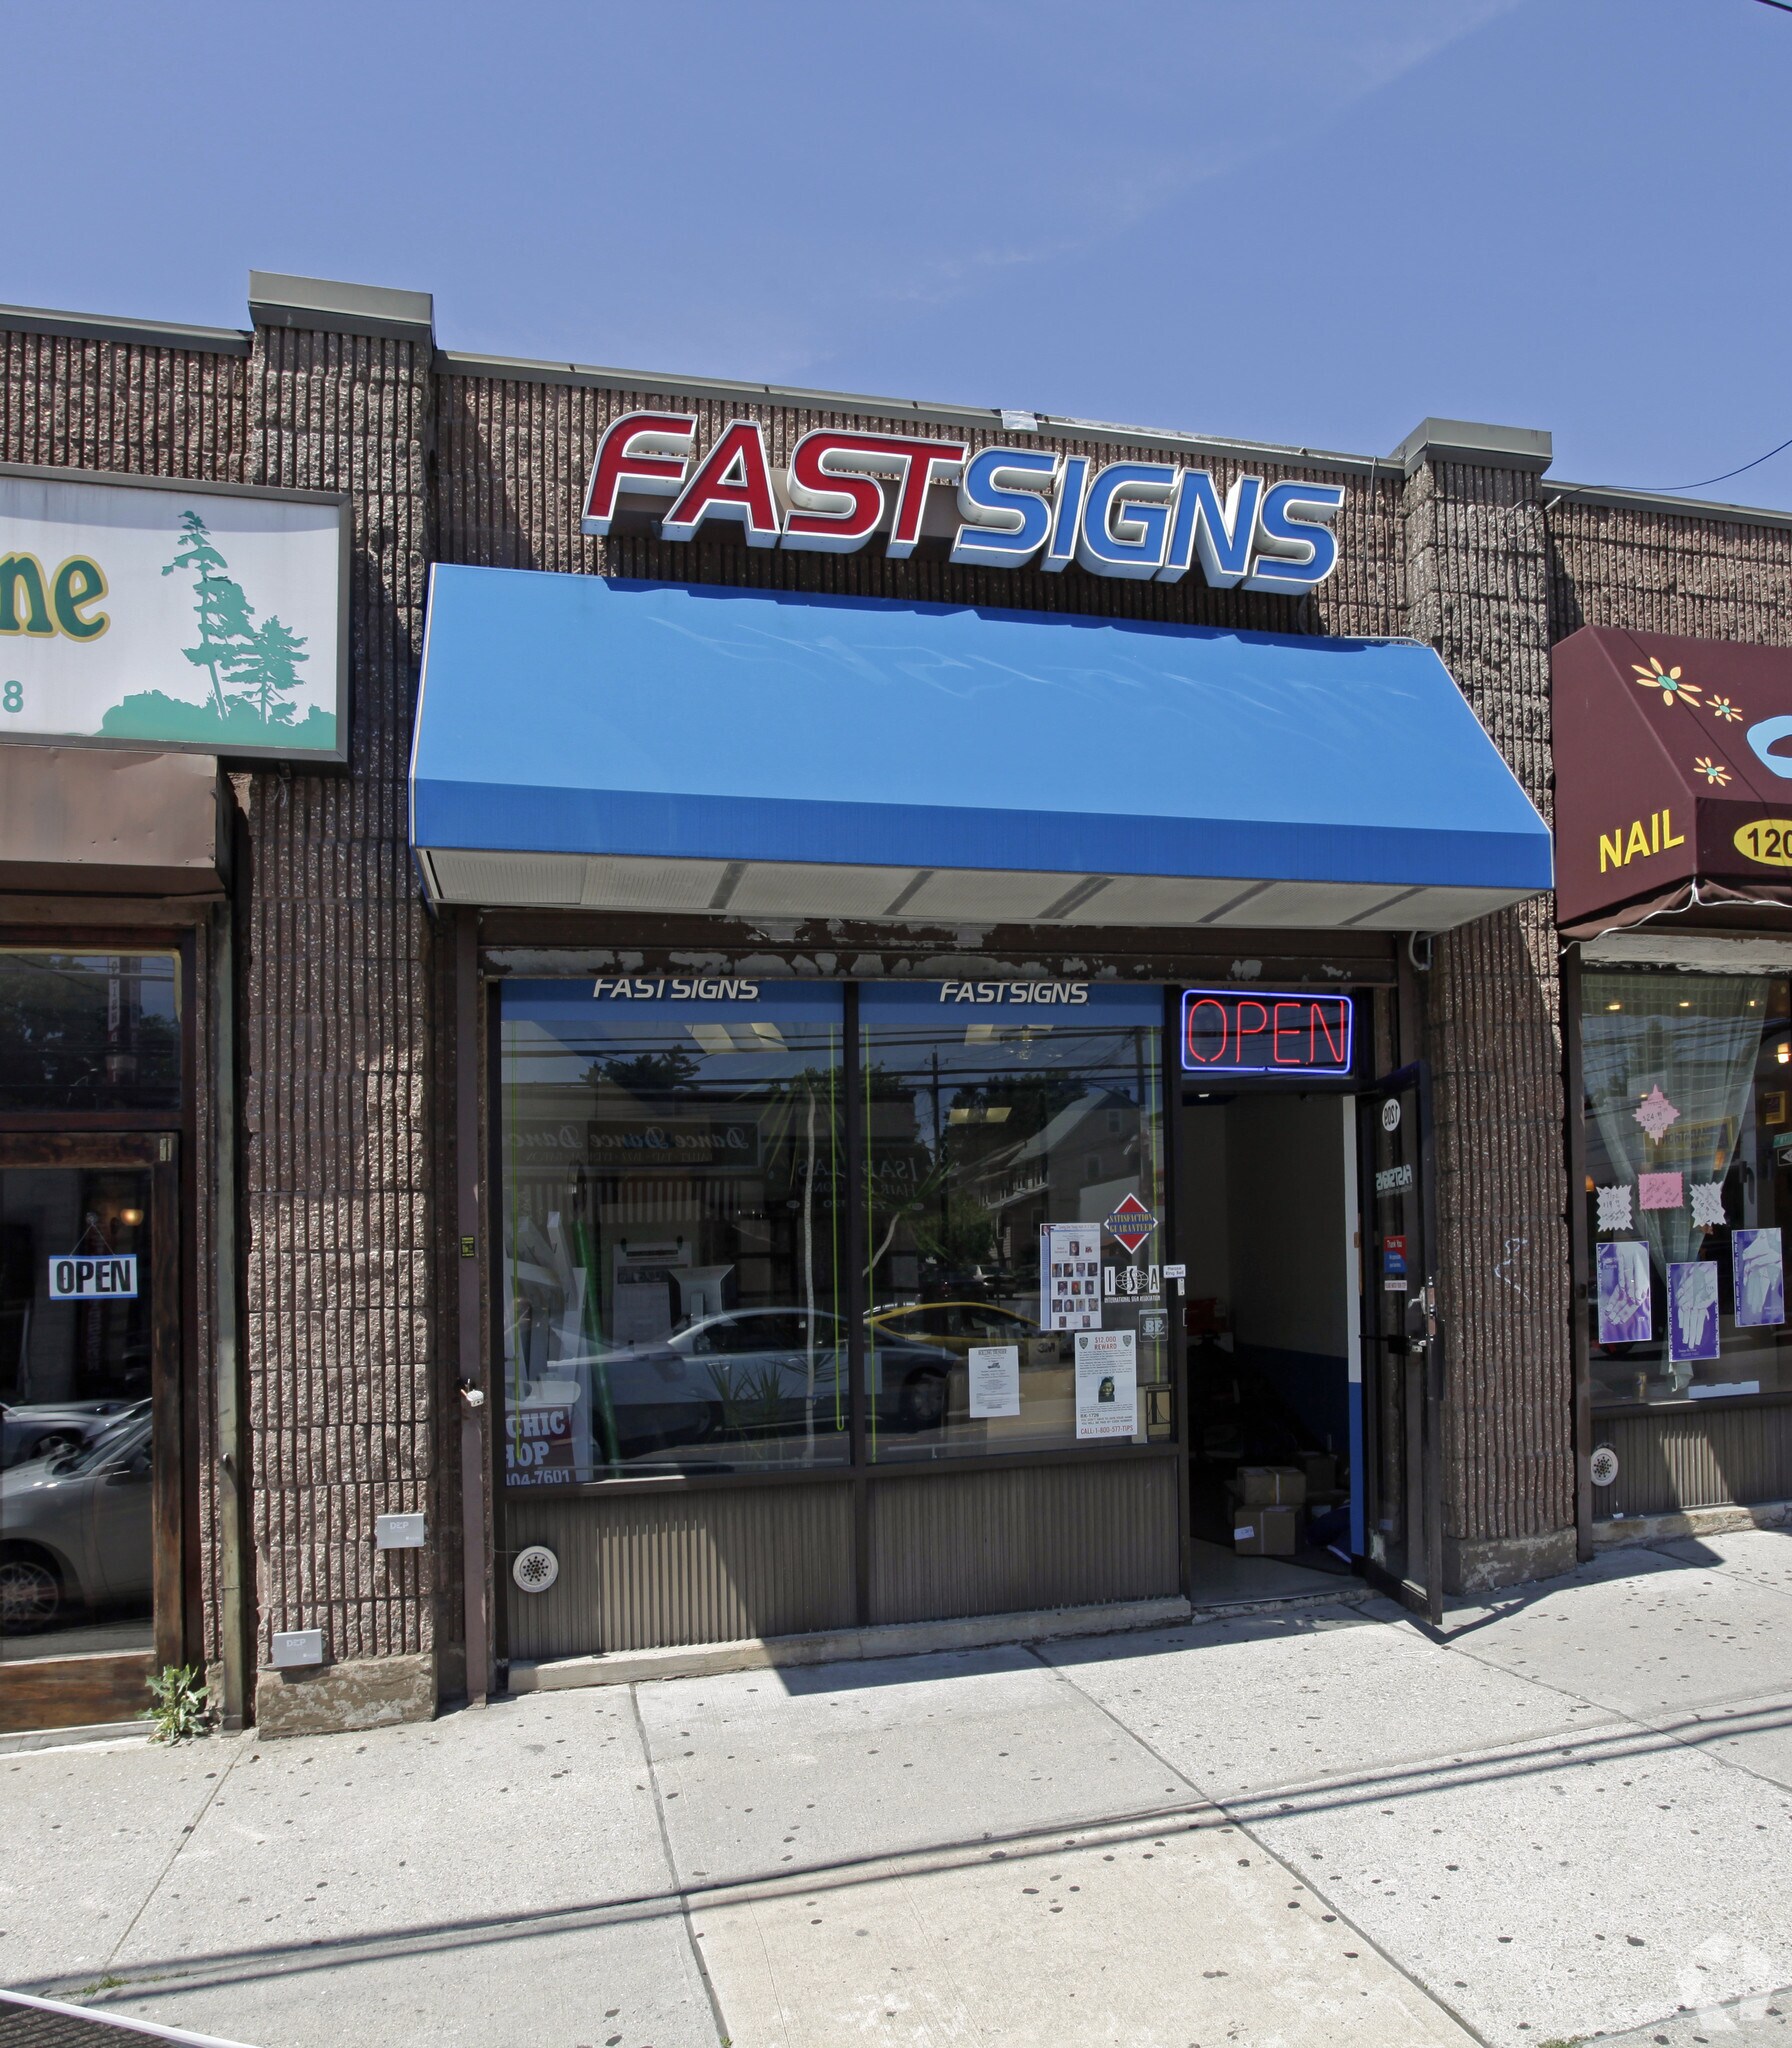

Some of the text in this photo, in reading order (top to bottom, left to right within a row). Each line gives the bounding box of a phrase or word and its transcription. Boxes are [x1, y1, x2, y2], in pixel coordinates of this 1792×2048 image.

[581, 411, 1345, 595] FASTSIGNS
[0, 551, 111, 643] ne
[1600, 809, 1685, 873] NAIL
[592, 978, 759, 999] FASTSIGNS
[939, 982, 1089, 1004] FASTSIGNS
[1188, 999, 1345, 1063] OPEN
[1109, 1213, 1153, 1223] SATISFACTION
[1109, 1223, 1153, 1233] GUARANTEED
[56, 1259, 131, 1293] OPEN
